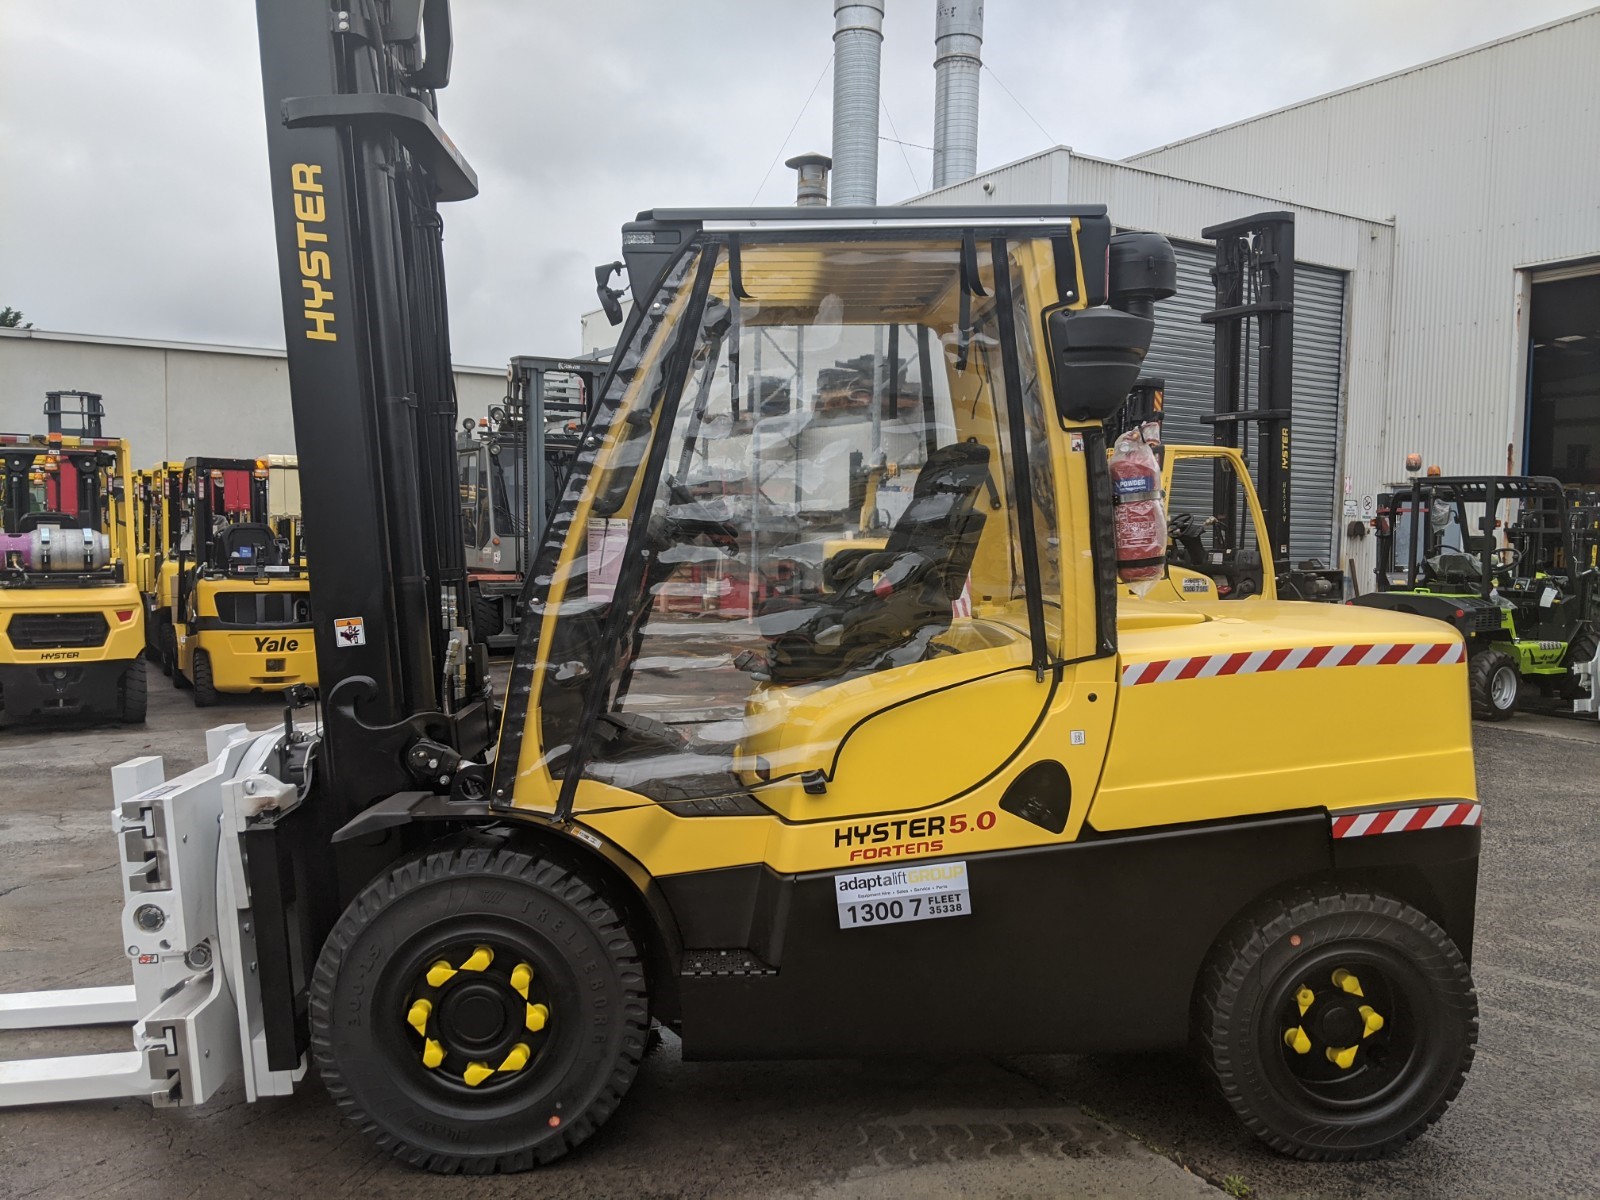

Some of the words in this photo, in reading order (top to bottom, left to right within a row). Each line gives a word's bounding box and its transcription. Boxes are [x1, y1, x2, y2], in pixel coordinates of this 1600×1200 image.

[291, 163, 337, 342] HYSTER
[1120, 479, 1146, 488] POWDER
[254, 636, 299, 653] Yale
[41, 651, 80, 660] HYSTER
[834, 815, 946, 848] HYSTER
[949, 810, 997, 834] 5.0
[849, 839, 944, 862] FORTENS
[928, 893, 962, 905] FLEET
[847, 900, 904, 923] 1300
[909, 898, 922, 917] 7
[928, 903, 963, 915] 35338
